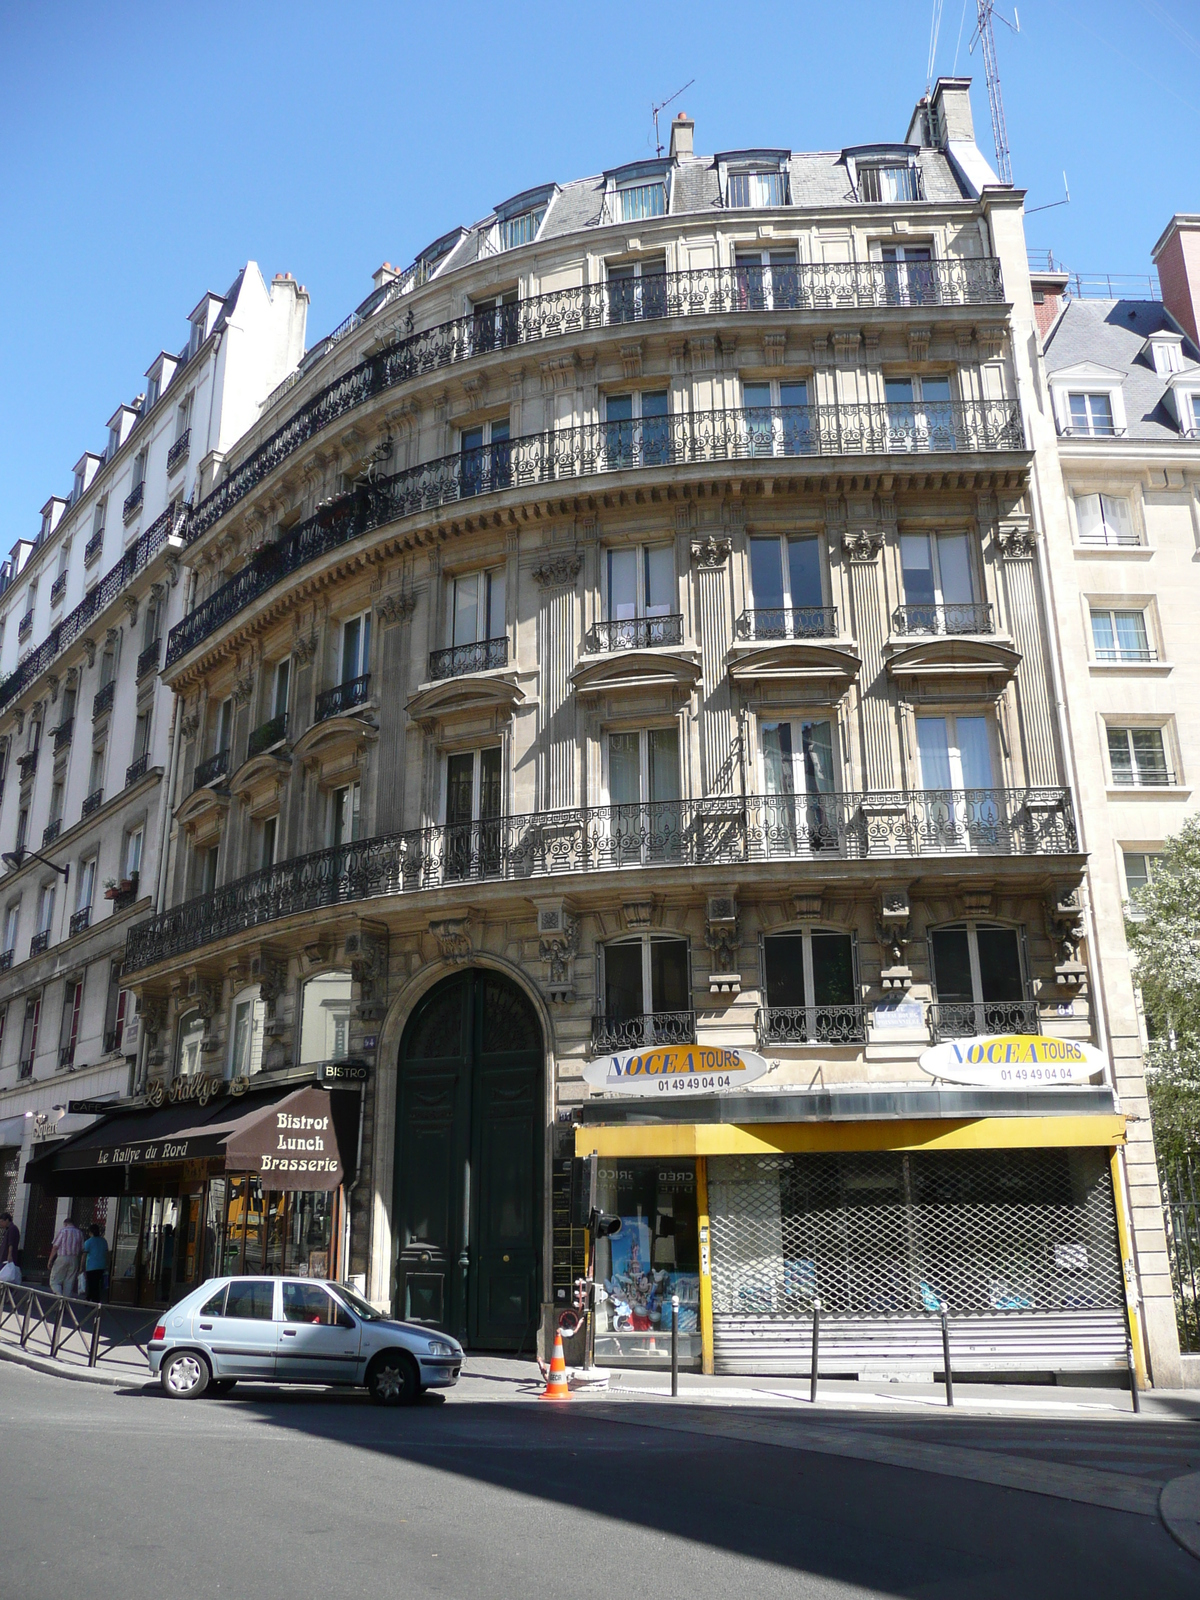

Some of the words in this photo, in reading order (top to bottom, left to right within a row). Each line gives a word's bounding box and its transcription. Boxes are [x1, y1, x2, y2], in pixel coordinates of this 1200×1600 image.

[1058, 1004, 1073, 1015] 64
[948, 1043, 1039, 1064] NOCEA
[1041, 1042, 1082, 1060] TOURS
[325, 1066, 367, 1078] BISTRO
[607, 1052, 695, 1076] NOCEA
[699, 1050, 741, 1068] TOURS
[1001, 1069, 1012, 1080] 01
[1015, 1069, 1028, 1080] 49
[1030, 1069, 1043, 1080] 49
[1045, 1068, 1057, 1079] 04
[1060, 1068, 1072, 1079] 04
[143, 1079, 164, 1108] Le
[169, 1072, 221, 1107] Rallye
[658, 1080, 669, 1092] 01
[672, 1079, 685, 1090] 49
[687, 1078, 700, 1089] 49
[702, 1077, 715, 1088] 04
[717, 1075, 731, 1087] 04
[276, 1112, 329, 1130] Bistrot
[276, 1134, 325, 1151] Lunch
[97, 1150, 109, 1164] Le
[112, 1147, 140, 1164] Rallye
[145, 1145, 158, 1159] du
[161, 1141, 189, 1158] Nord
[260, 1154, 338, 1172] Brasserie
